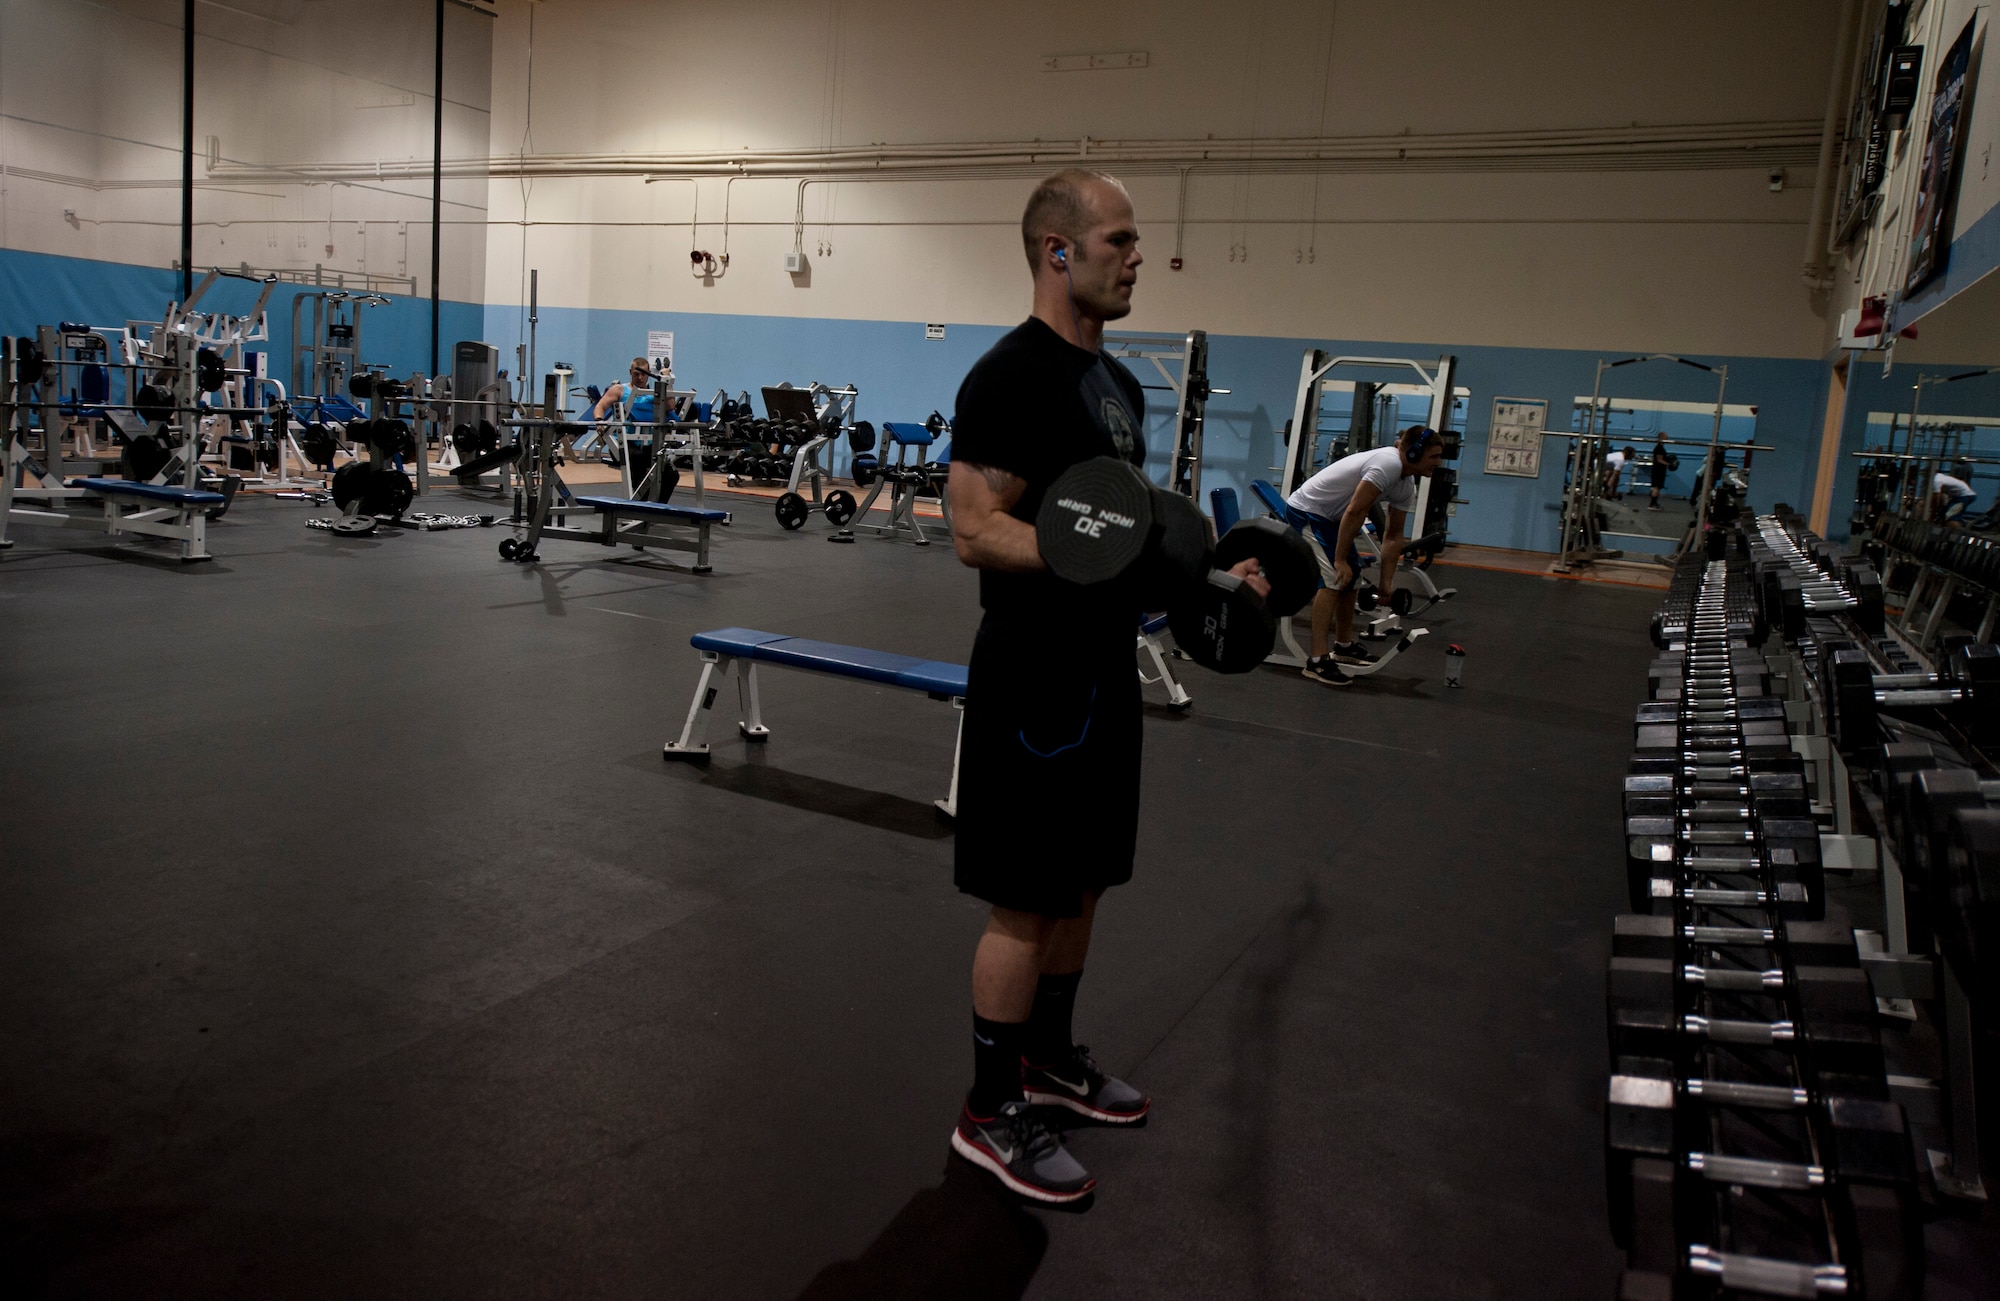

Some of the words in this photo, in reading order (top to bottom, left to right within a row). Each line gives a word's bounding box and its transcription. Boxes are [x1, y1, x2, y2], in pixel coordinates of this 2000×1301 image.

[1057, 498, 1092, 514] GRIP
[1074, 516, 1108, 538] 30
[1099, 509, 1136, 528] IRON
[1204, 615, 1218, 640] 30
[1220, 602, 1229, 630] GRIP
[1216, 634, 1225, 662] IRON
